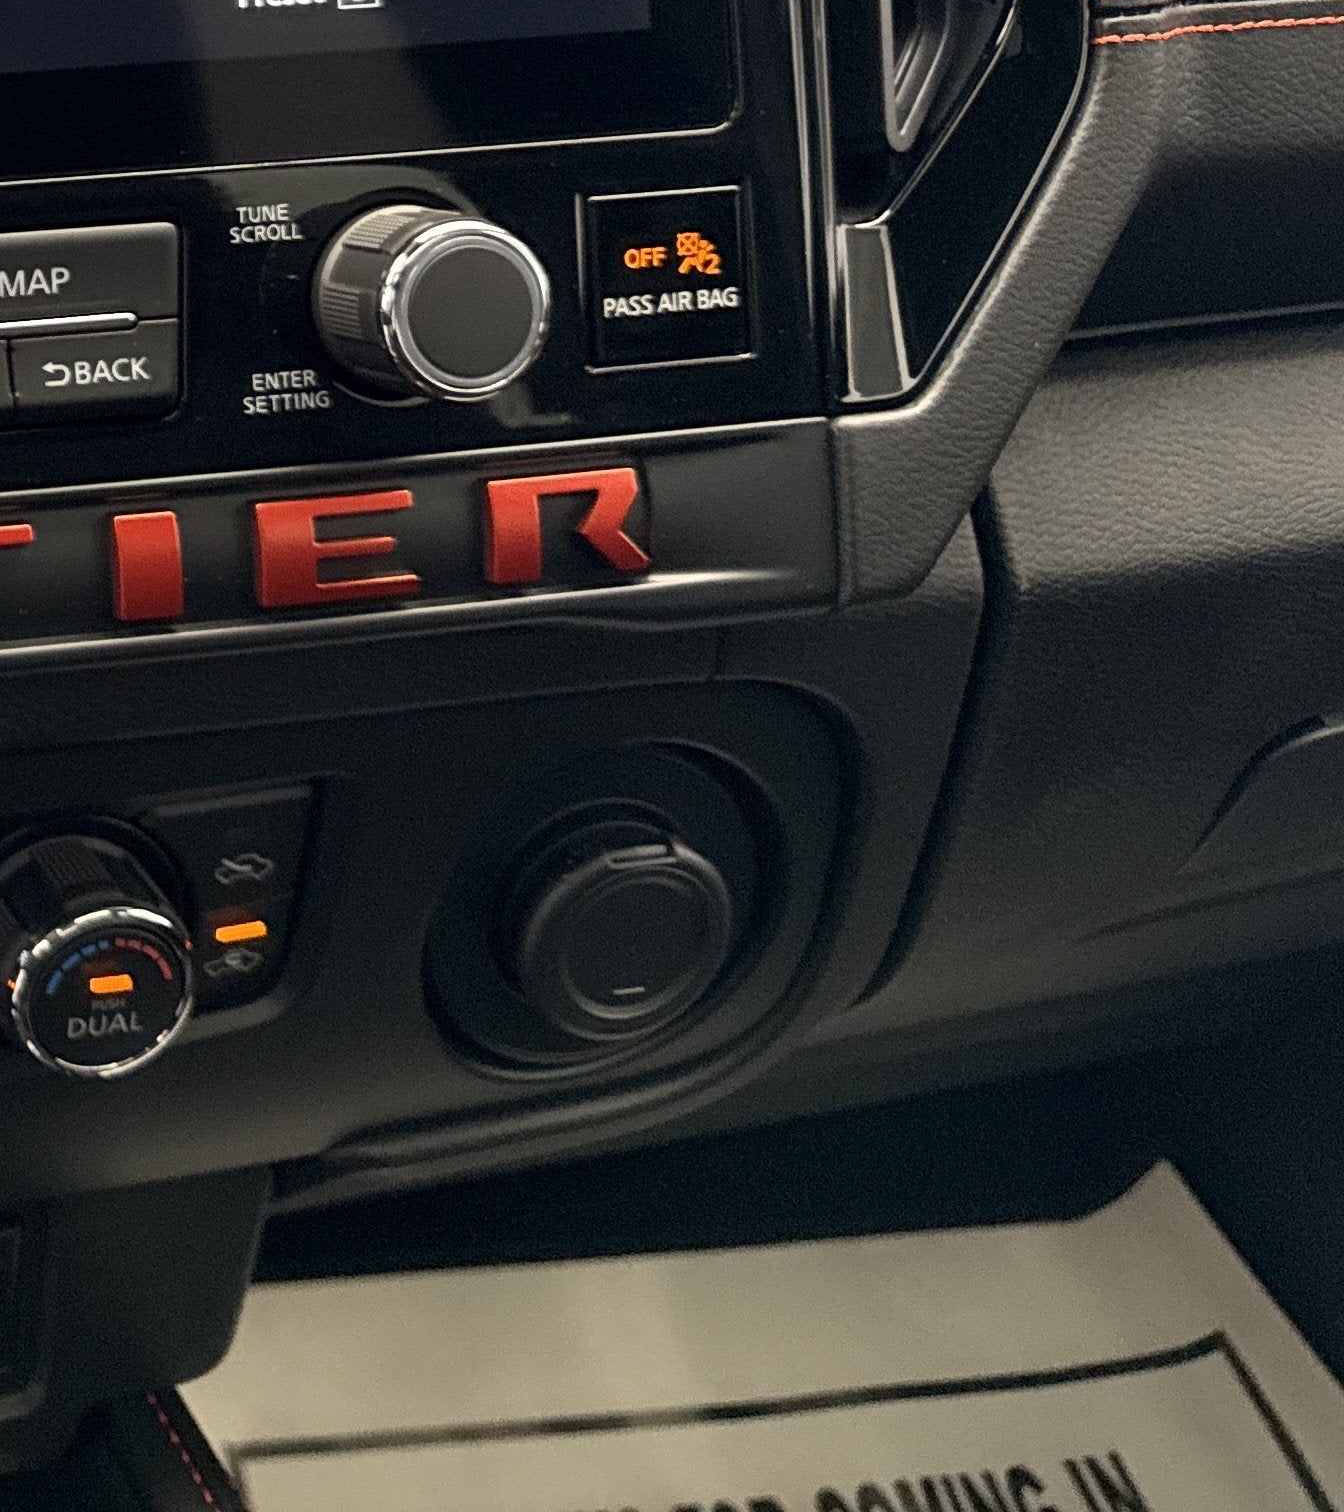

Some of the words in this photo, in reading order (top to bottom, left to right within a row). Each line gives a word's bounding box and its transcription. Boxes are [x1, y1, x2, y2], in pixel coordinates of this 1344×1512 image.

[236, 204, 290, 224] TUNE
[229, 222, 303, 244] SCROLL
[623, 246, 667, 269] OFF
[602, 294, 654, 319] PASS
[657, 290, 693, 313] AIR
[696, 286, 739, 310] BAG
[74, 356, 151, 385] BACK
[251, 368, 318, 392] ENTER
[242, 390, 332, 415] SETTING
[66, 1011, 144, 1041] DUAL
